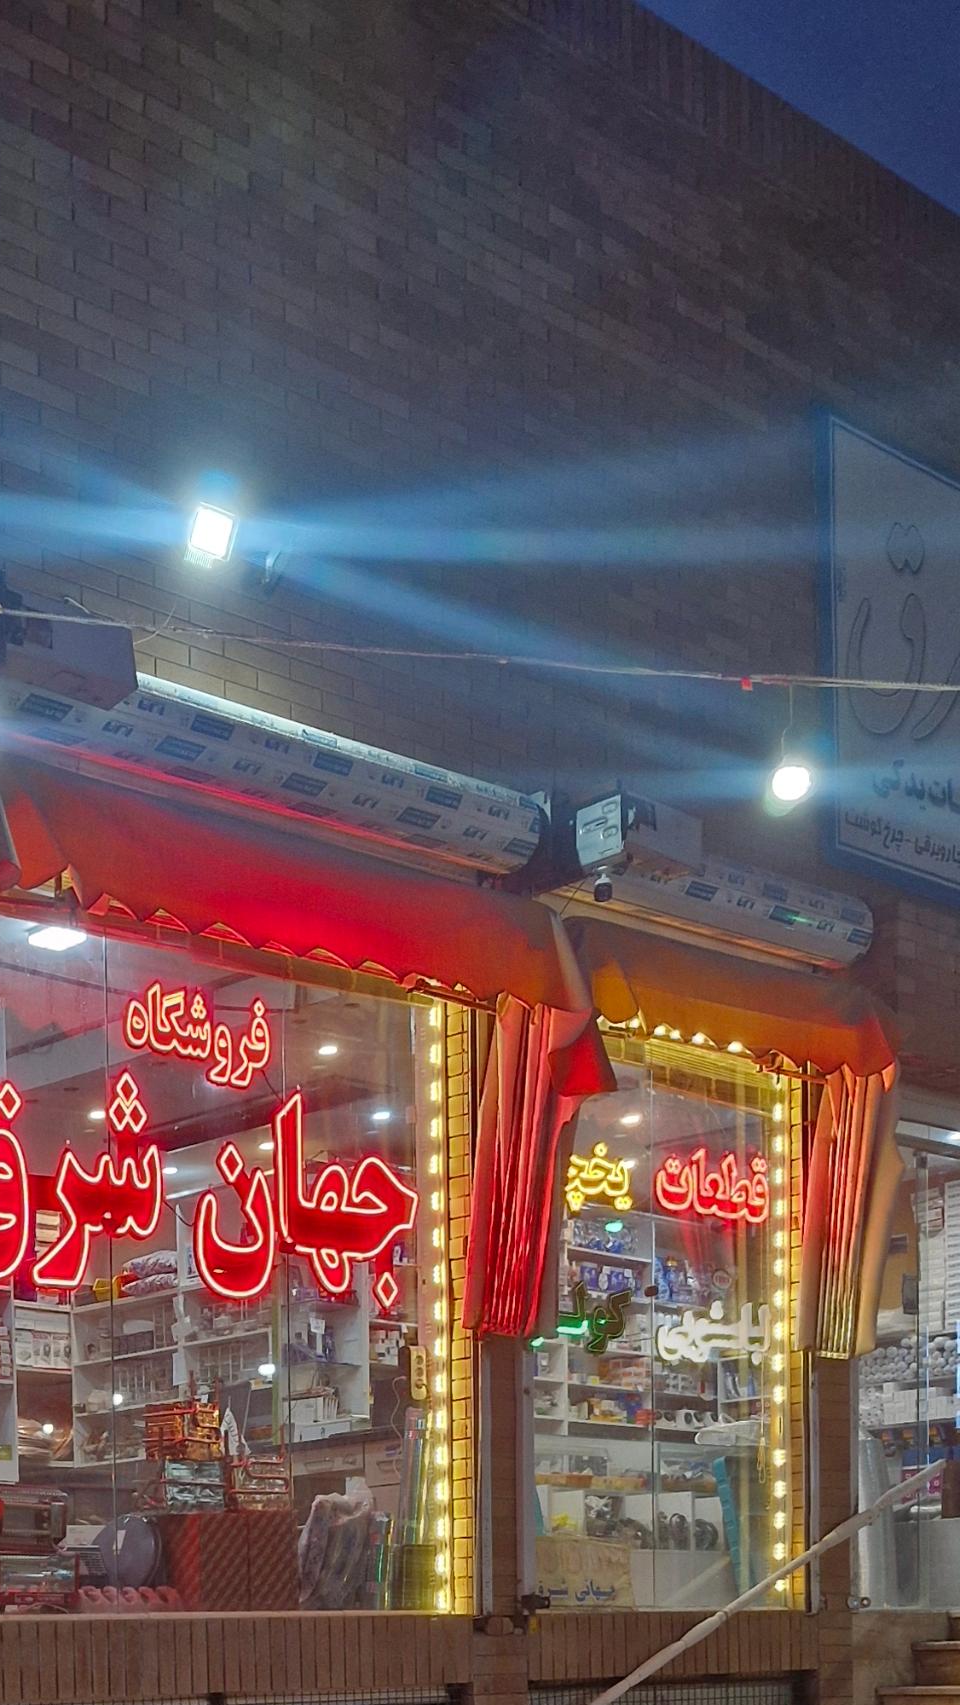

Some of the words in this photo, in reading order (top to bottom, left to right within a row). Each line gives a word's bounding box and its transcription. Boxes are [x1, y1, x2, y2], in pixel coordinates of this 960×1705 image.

[125, 981, 271, 1088] فروشگاه
[193, 1087, 419, 1310] جهان
[655, 1147, 771, 1224] قطعات
